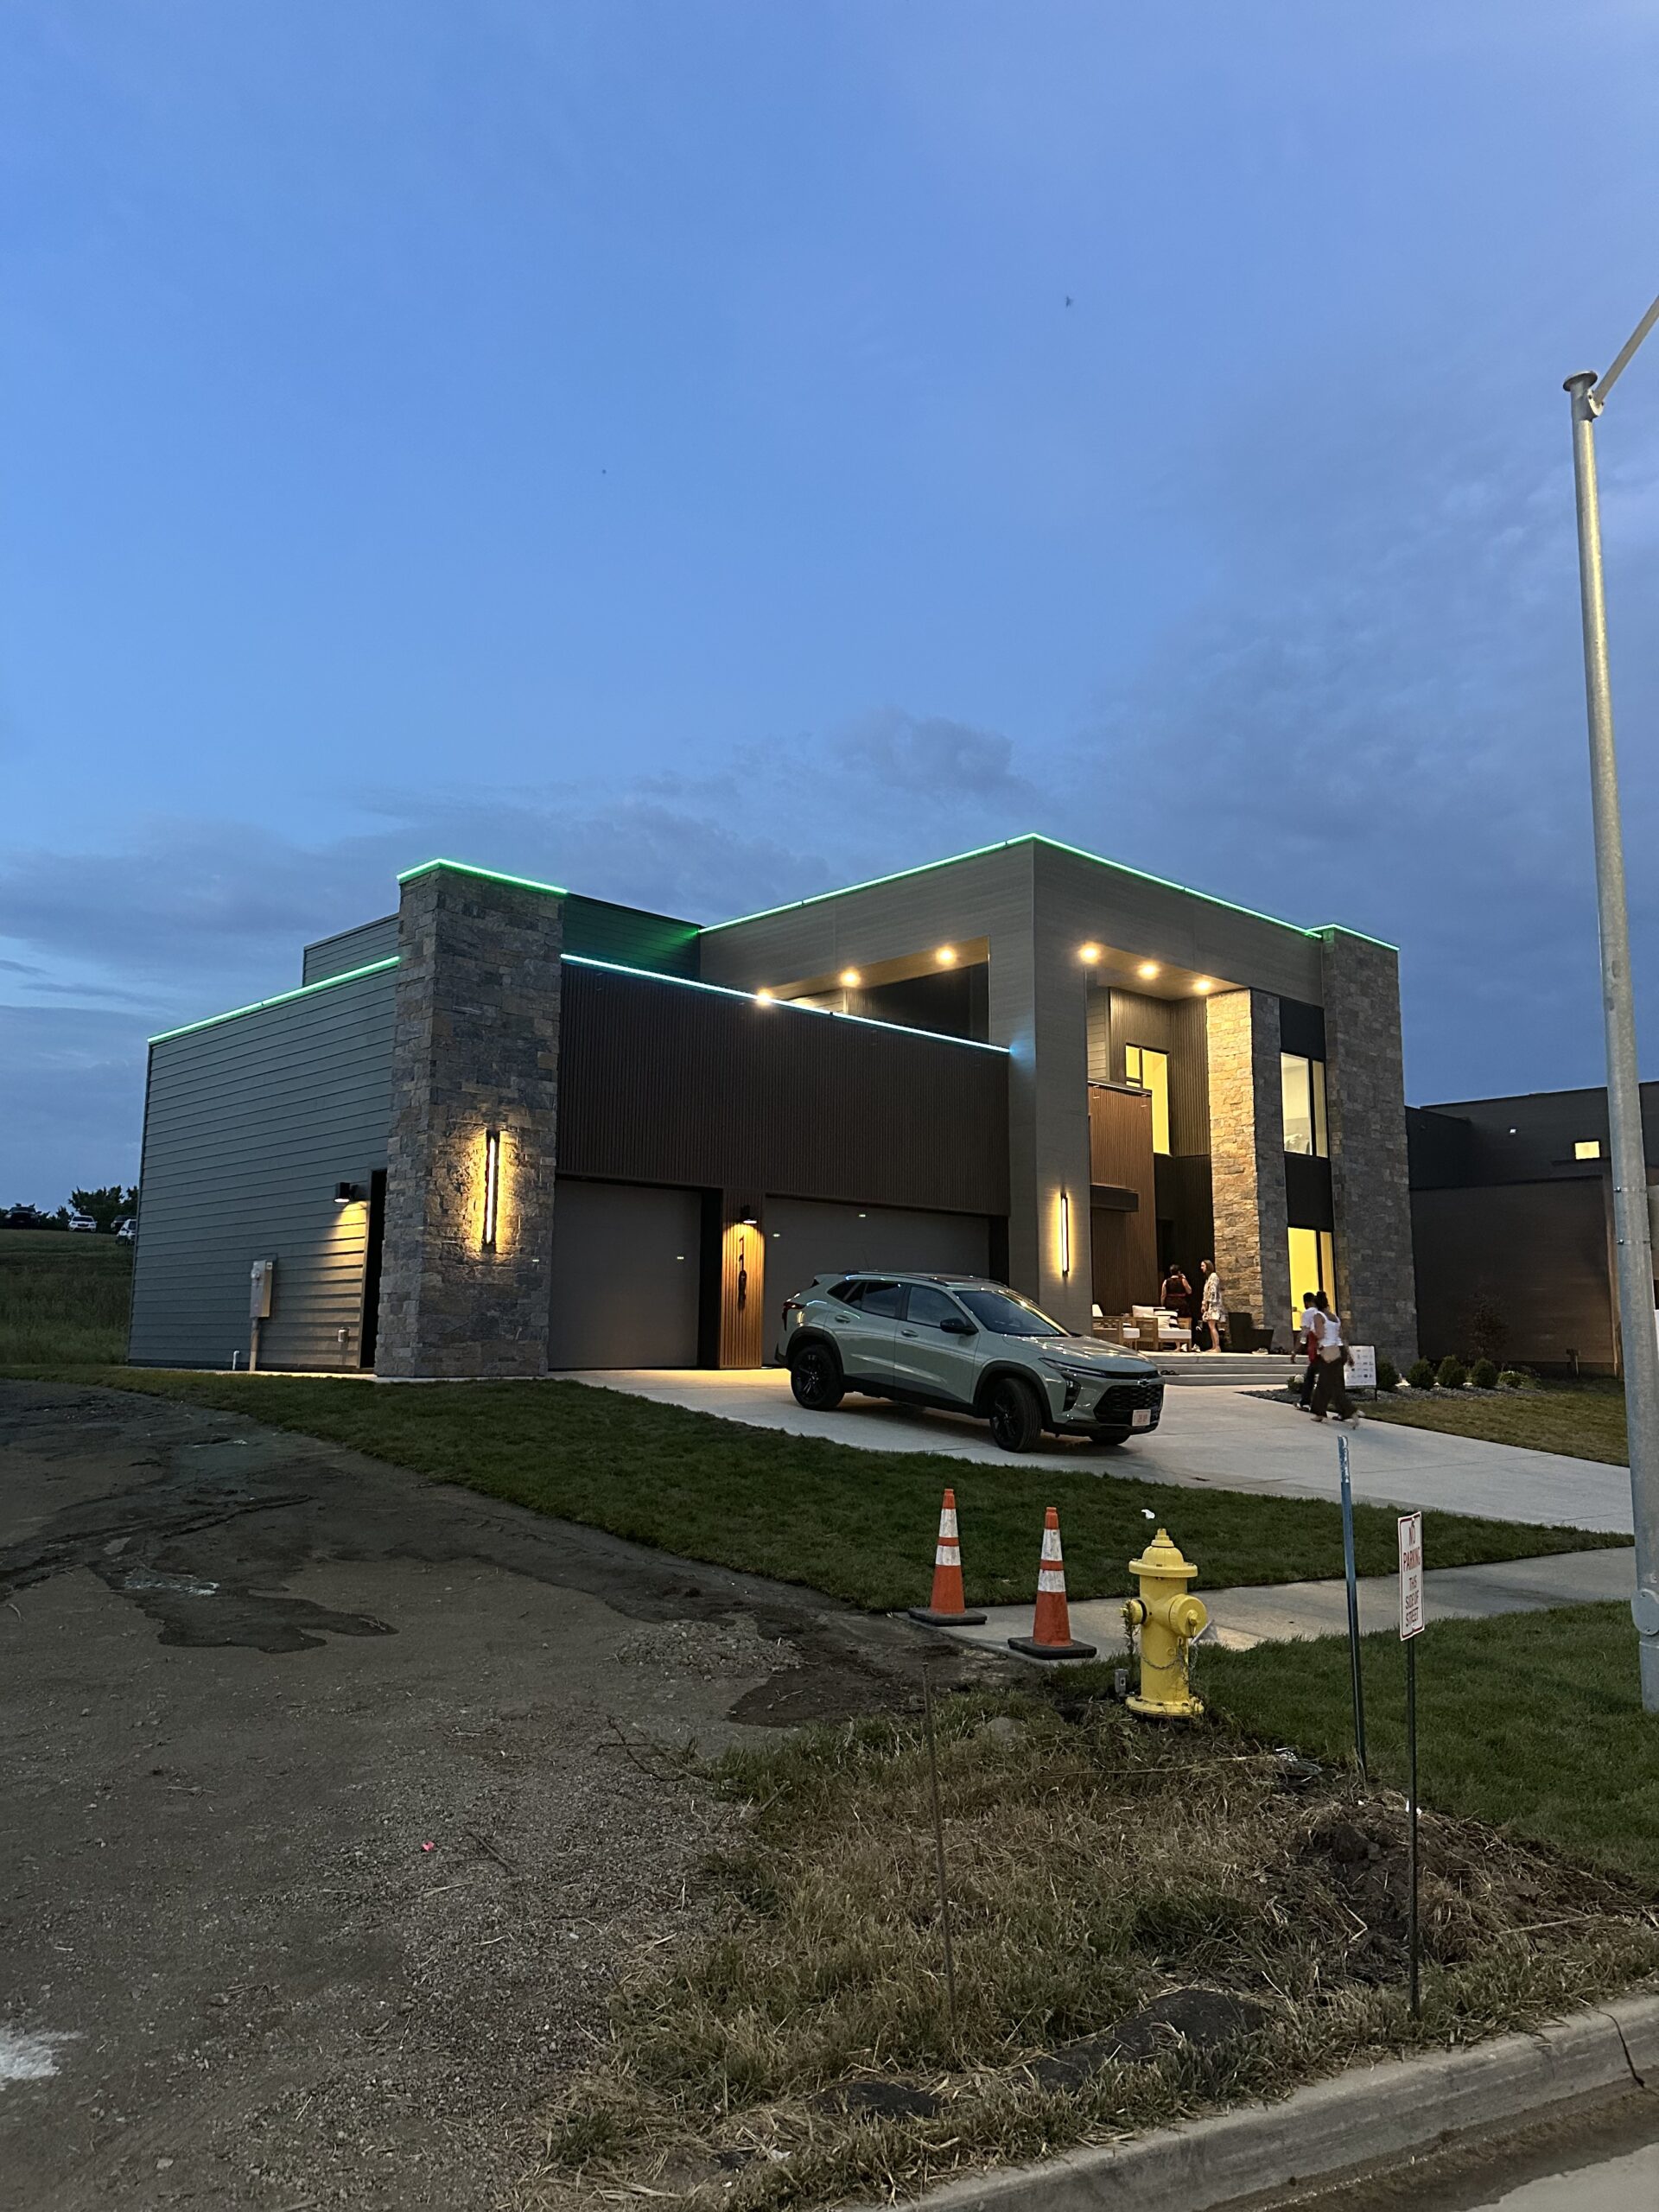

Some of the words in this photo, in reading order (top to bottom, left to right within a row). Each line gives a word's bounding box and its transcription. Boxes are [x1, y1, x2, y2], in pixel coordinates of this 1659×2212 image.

[1408, 1524, 1415, 1546] NO
[1403, 1547, 1421, 1572] PARKING
[1405, 1592, 1414, 1609] SIDE
[1405, 1607, 1419, 1627] STREET
